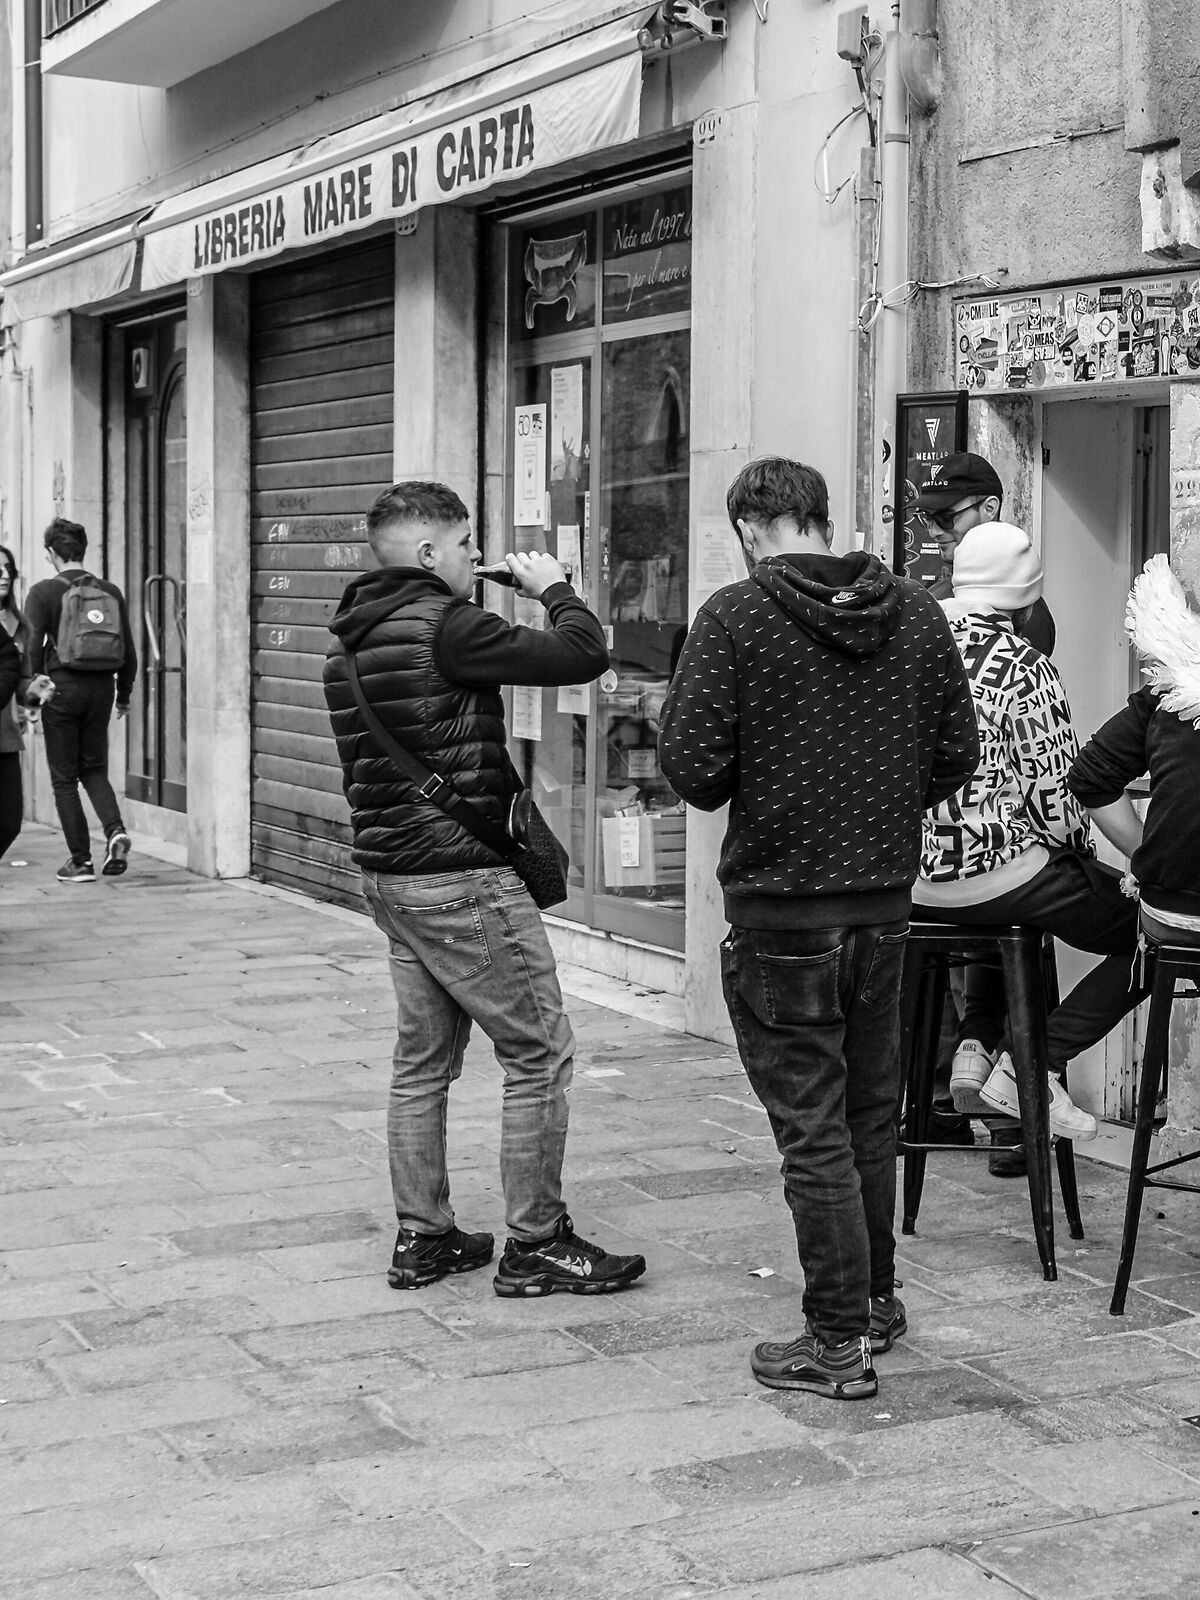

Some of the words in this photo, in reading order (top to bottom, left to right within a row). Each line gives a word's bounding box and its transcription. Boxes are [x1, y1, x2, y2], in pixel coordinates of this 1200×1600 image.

[193, 195, 286, 269] LIBRERIA
[303, 163, 373, 236] MARE
[391, 146, 418, 208] DI
[436, 104, 535, 192] CARTA
[657, 212, 685, 241] 1997
